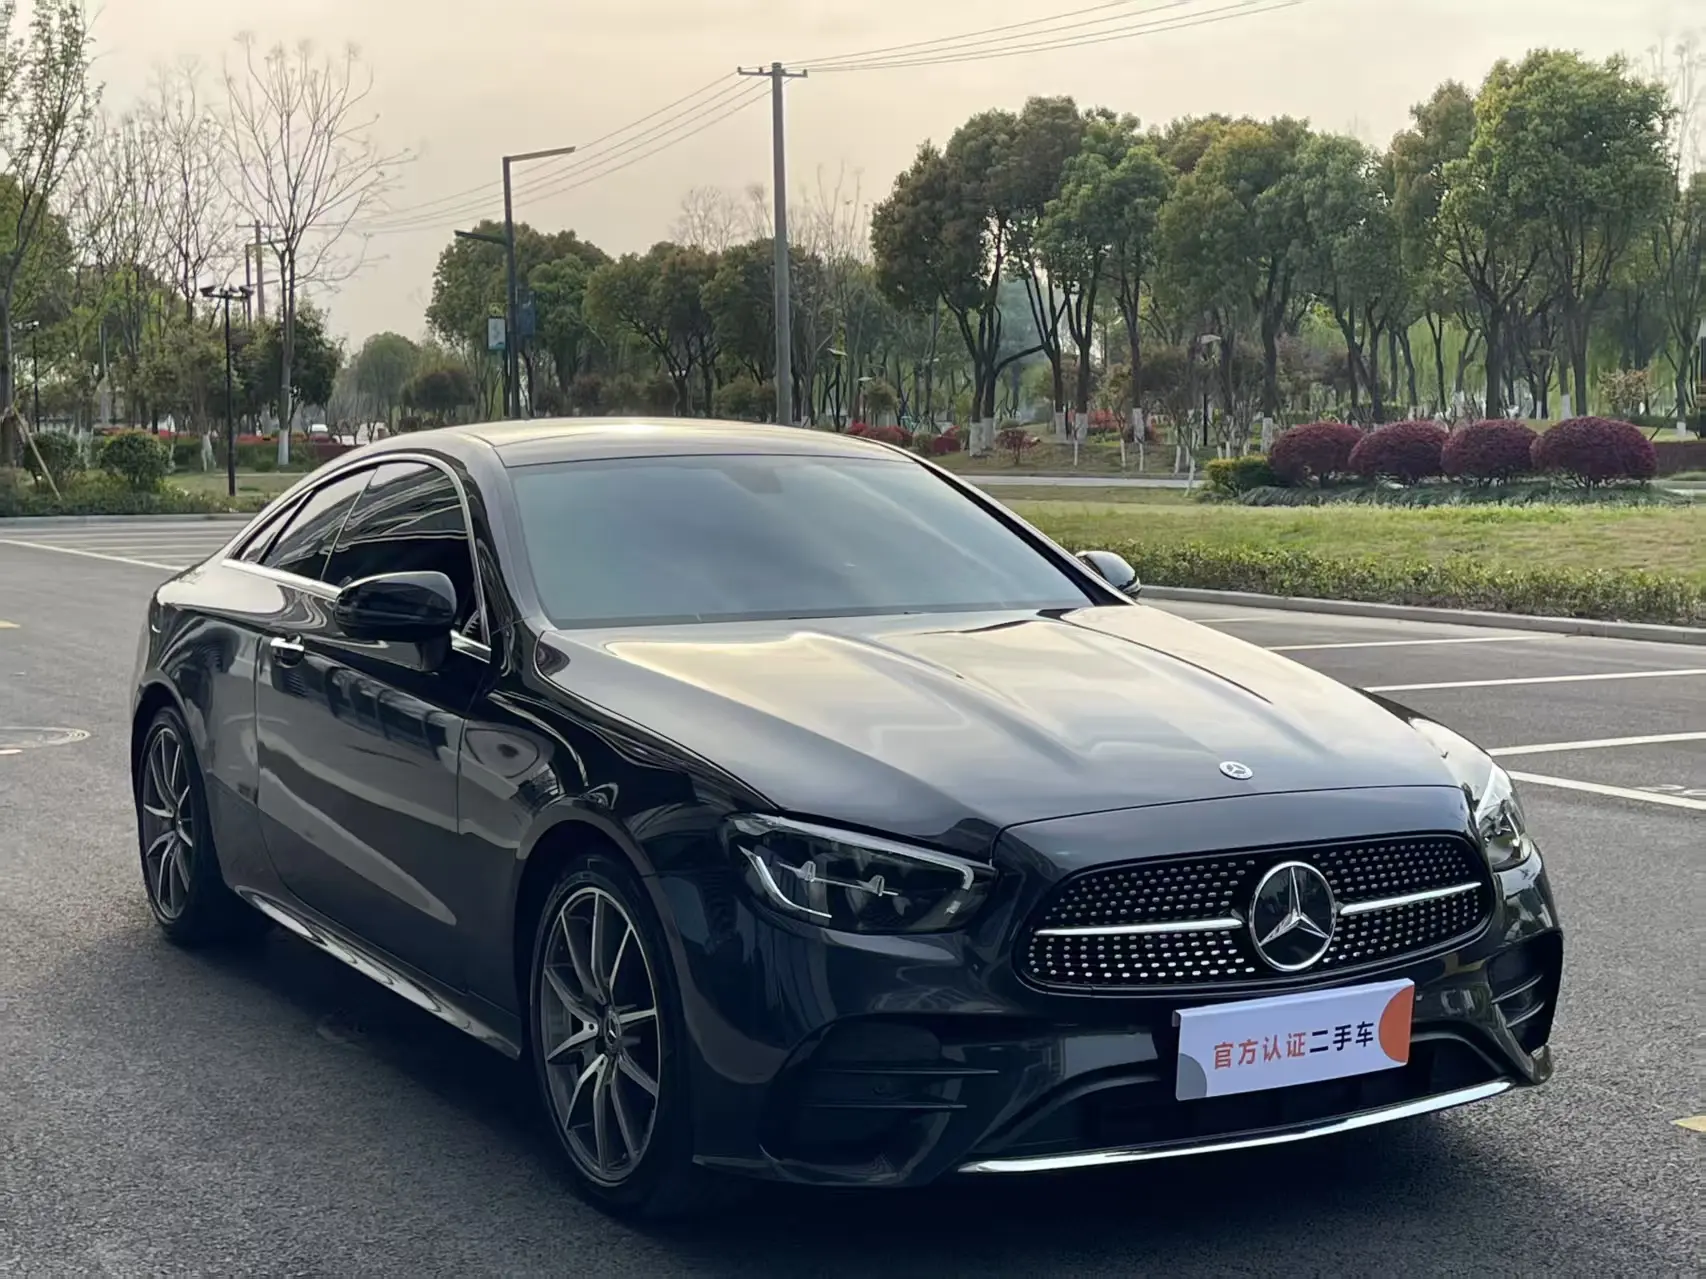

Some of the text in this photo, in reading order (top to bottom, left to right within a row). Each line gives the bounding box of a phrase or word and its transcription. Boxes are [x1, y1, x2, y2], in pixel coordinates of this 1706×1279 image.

[1213, 1020, 1375, 1070] 官方认证二手车
